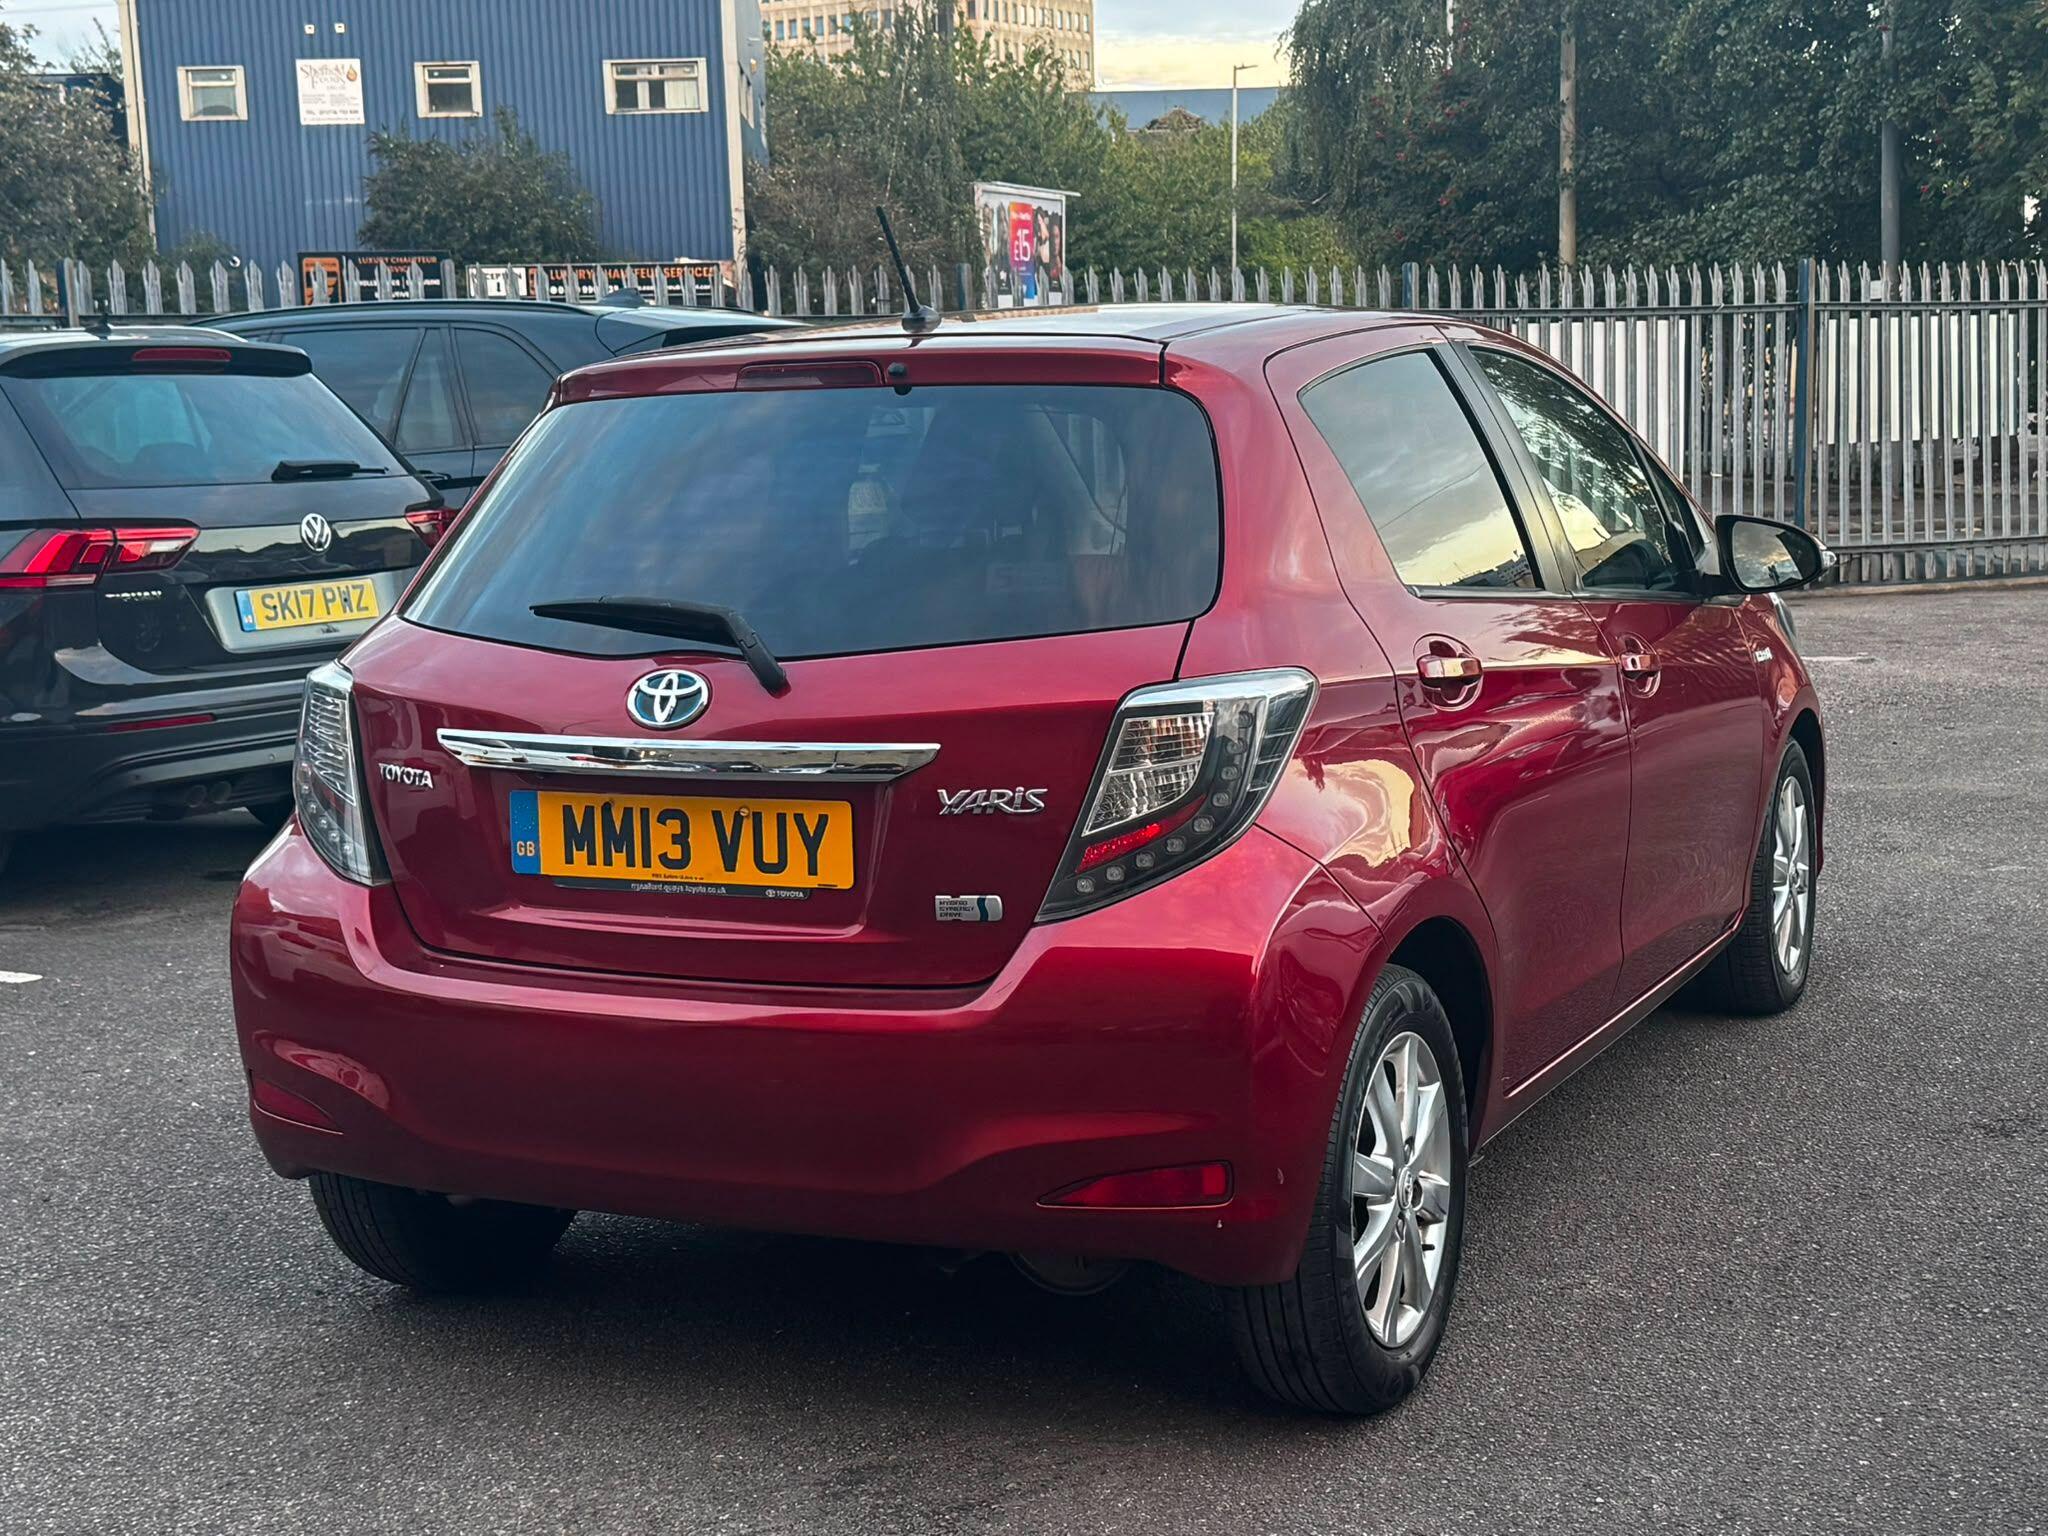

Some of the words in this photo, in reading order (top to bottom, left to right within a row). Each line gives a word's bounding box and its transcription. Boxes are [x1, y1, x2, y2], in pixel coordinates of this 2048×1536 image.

[260, 588, 315, 622] SK17
[321, 583, 370, 616] PWZ
[378, 762, 434, 789] TOYOTA
[516, 840, 536, 857] GB
[562, 803, 692, 871] MM13
[711, 809, 830, 877] VUY
[776, 890, 804, 898] TOYOTA
